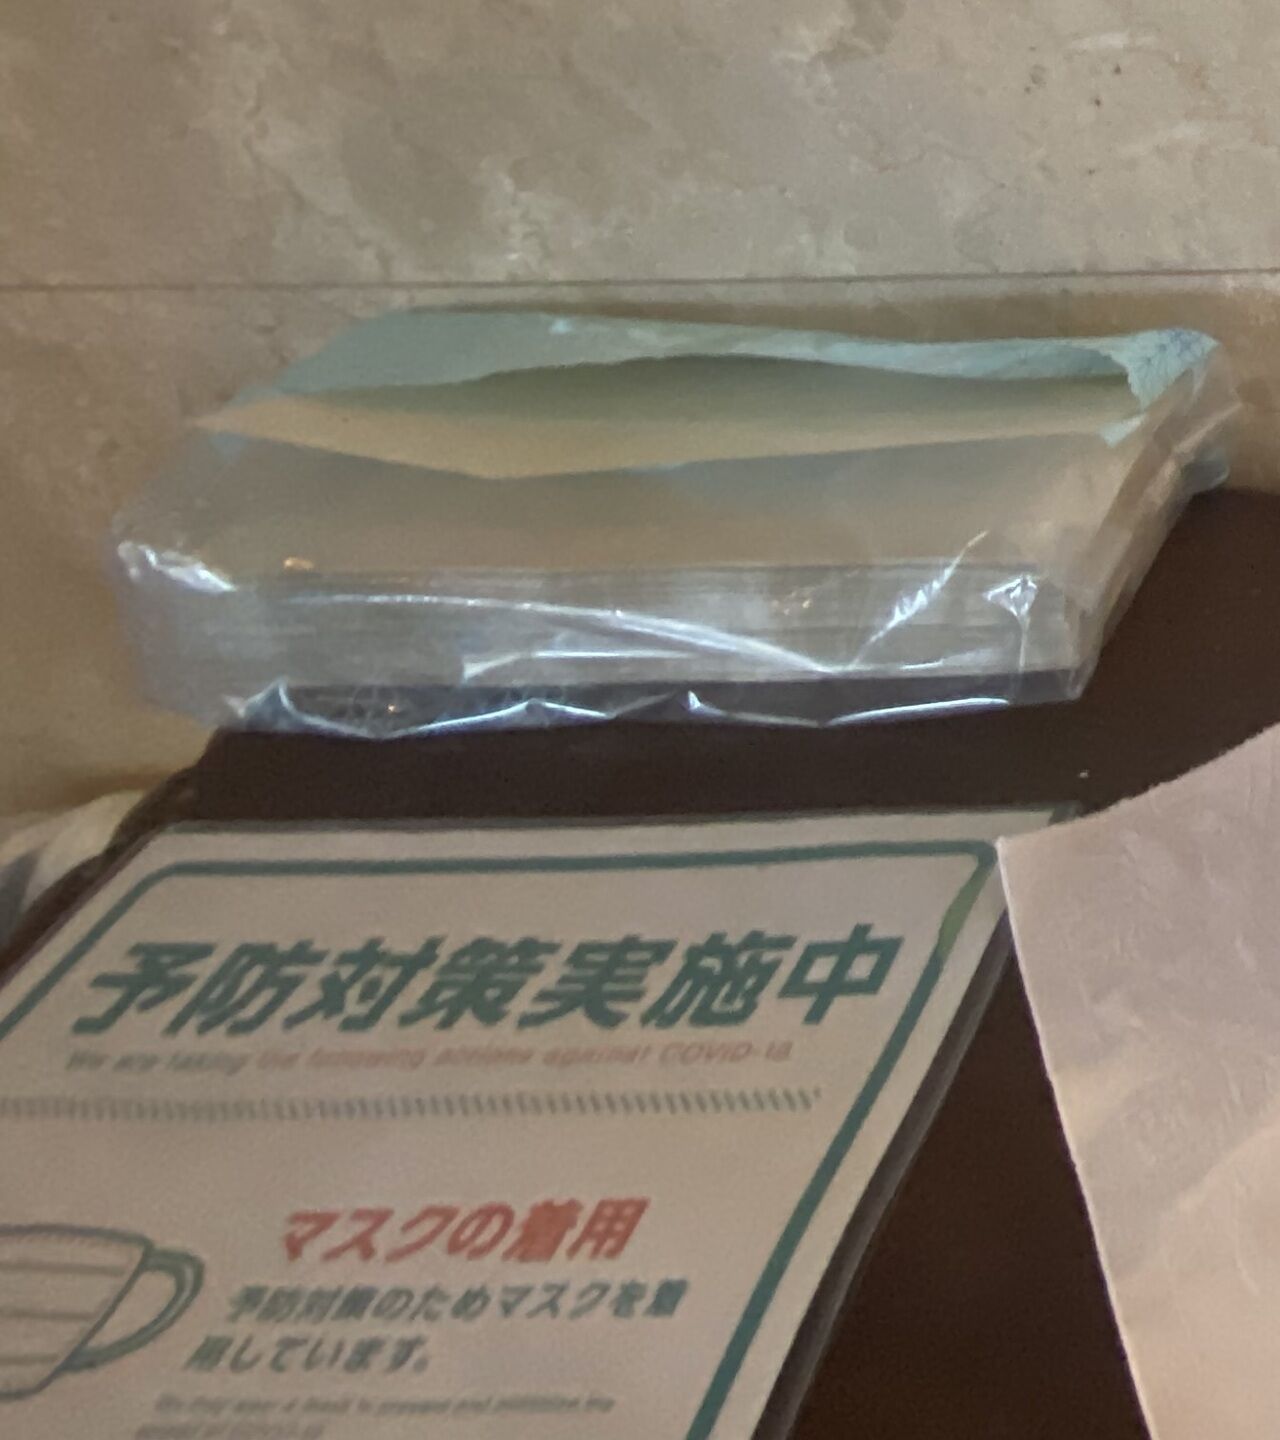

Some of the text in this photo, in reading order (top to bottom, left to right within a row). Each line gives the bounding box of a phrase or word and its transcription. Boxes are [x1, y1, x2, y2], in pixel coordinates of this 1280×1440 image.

[70, 923, 904, 1036] 予防対策実施中
[281, 1197, 650, 1262] マスクの着用
